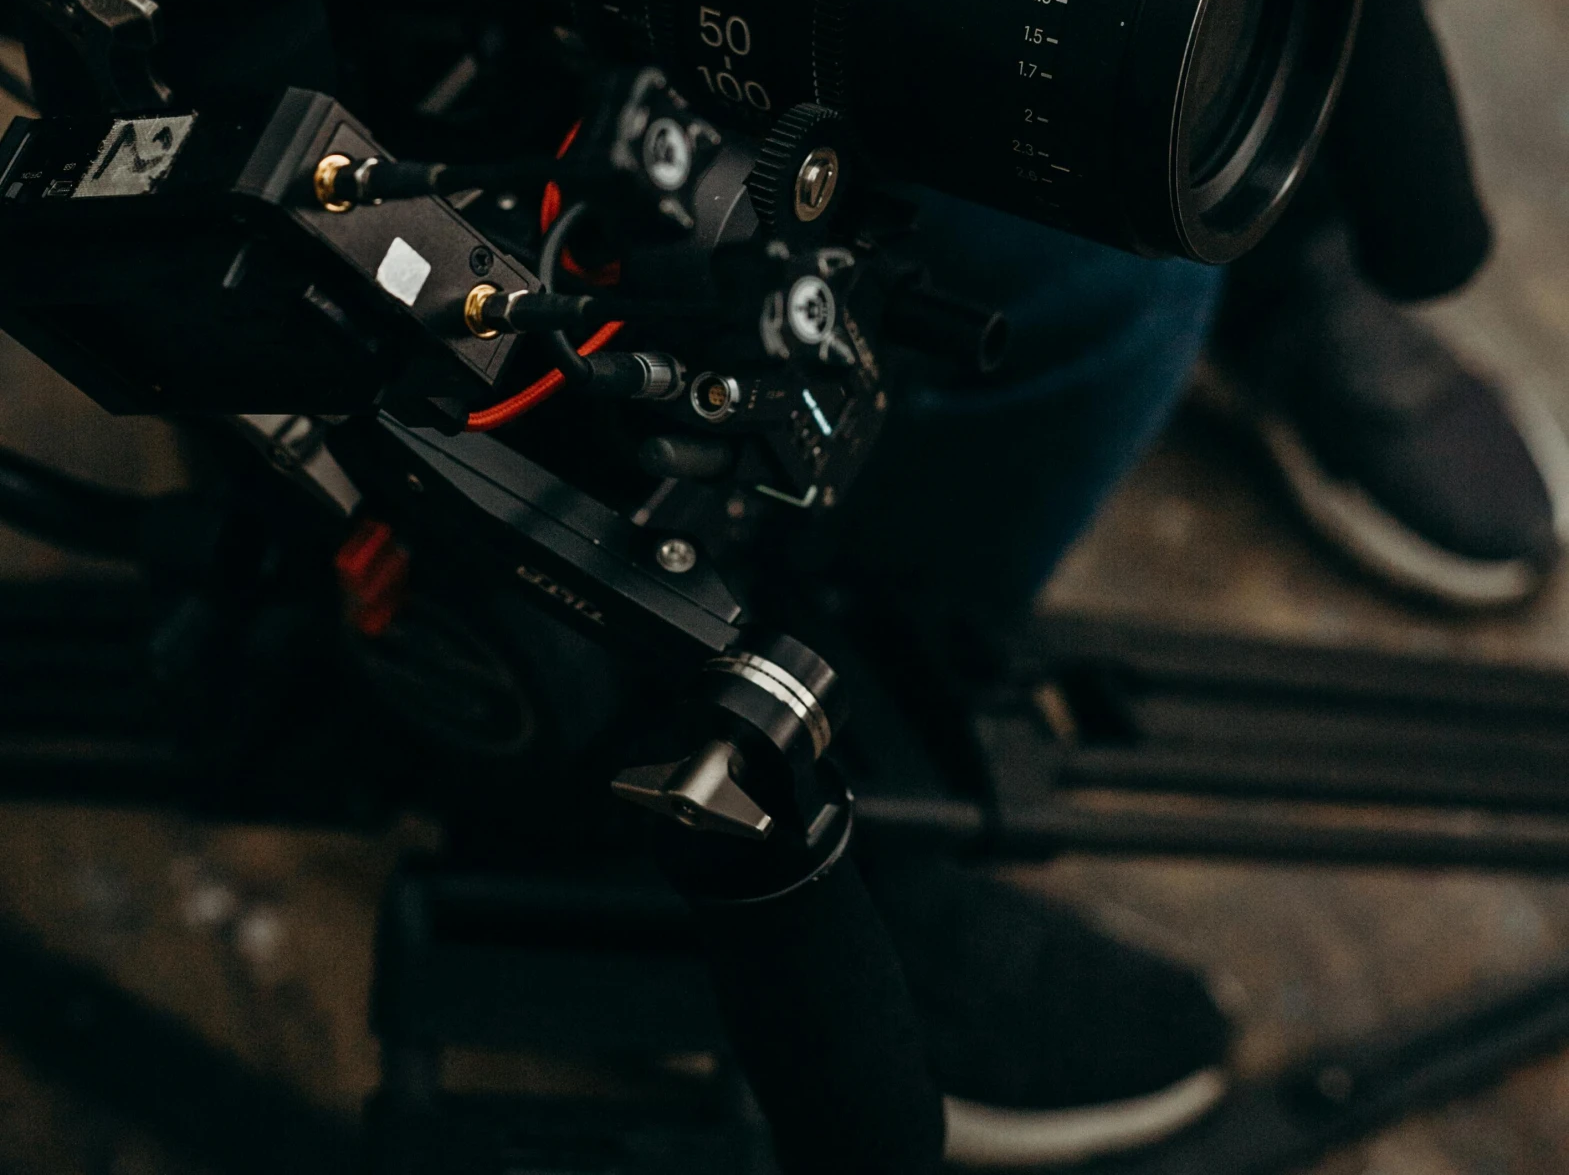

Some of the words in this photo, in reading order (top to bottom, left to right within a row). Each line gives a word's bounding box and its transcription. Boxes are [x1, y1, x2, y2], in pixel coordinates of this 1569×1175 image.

[699, 5, 751, 56] 50
[1024, 25, 1044, 45] 1.5
[1017, 60, 1038, 79] 1.7
[696, 65, 771, 112] 100
[1024, 108, 1033, 123] 2
